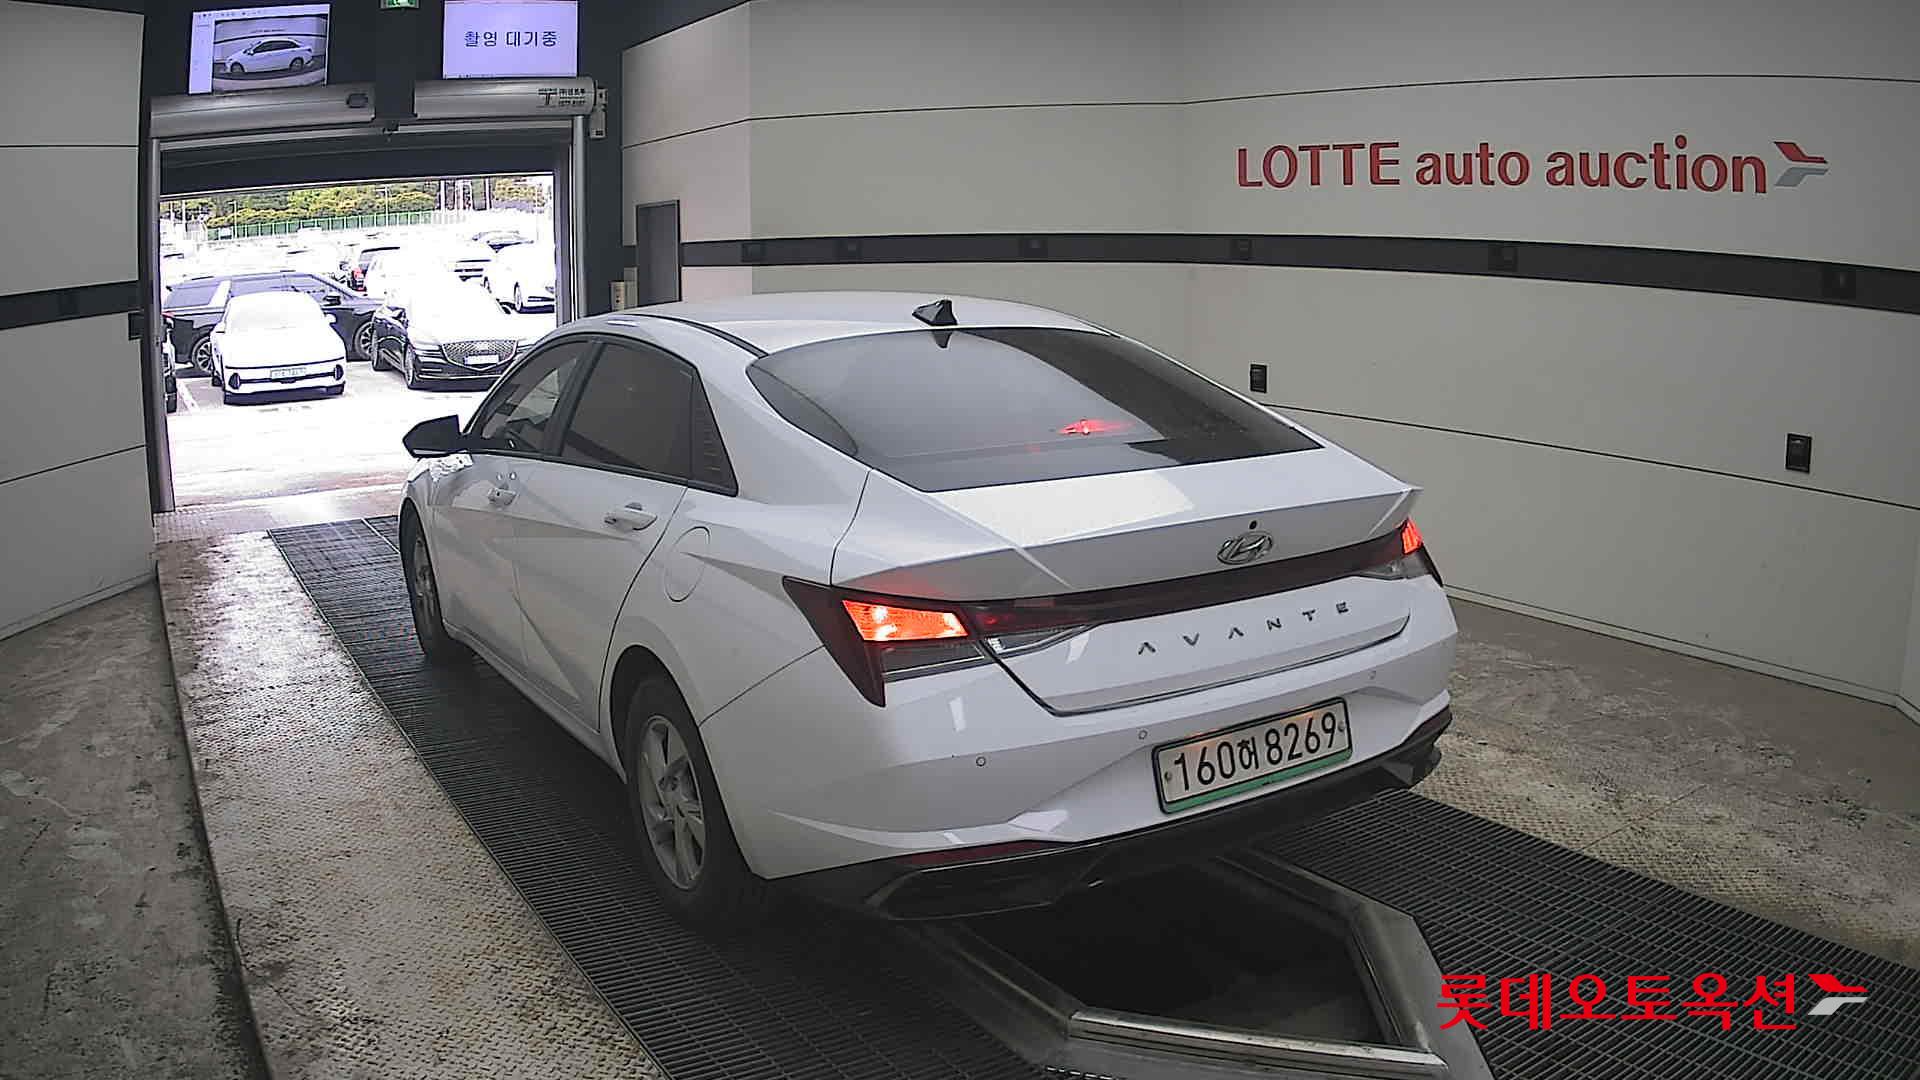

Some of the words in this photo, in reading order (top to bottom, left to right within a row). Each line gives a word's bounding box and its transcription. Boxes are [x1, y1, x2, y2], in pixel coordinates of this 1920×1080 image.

[464, 30, 498, 48] 촬영
[506, 30, 559, 48] 대기중
[1237, 142, 1401, 188] LOTTE
[1415, 142, 1530, 187] auto
[1545, 136, 1768, 194] auction
[1137, 600, 1350, 656] AVANTE
